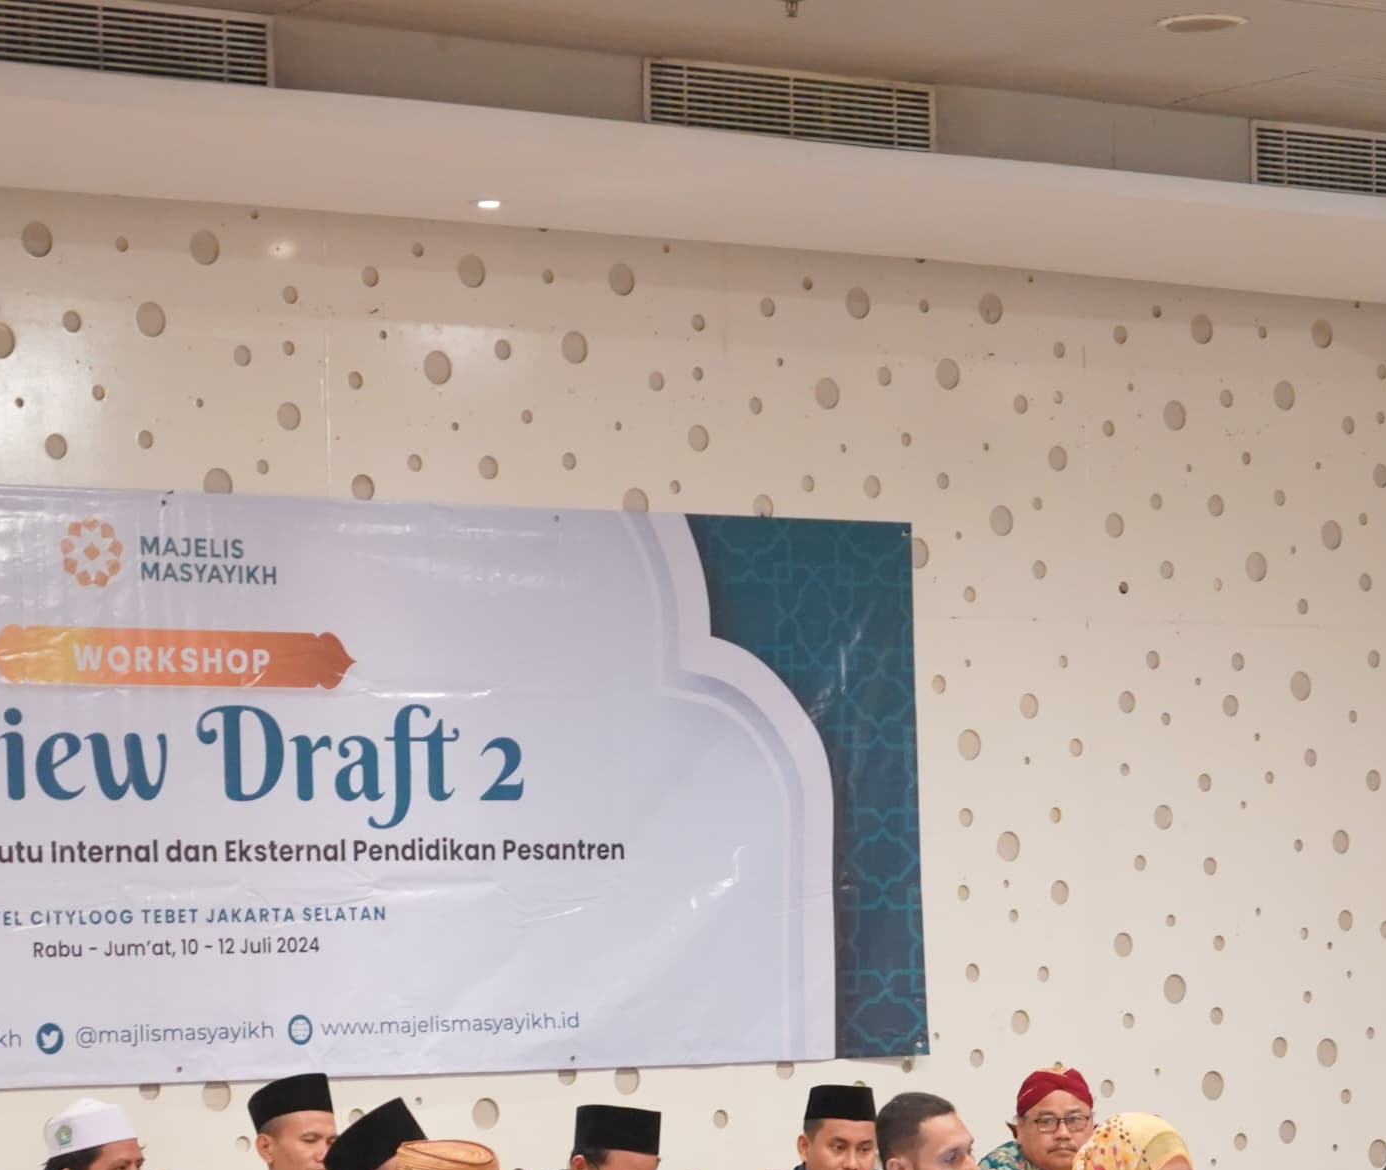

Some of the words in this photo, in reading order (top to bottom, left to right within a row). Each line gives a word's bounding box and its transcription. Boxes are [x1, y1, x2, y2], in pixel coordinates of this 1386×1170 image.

[140, 535, 245, 559] MAJELIS
[140, 561, 278, 586] MASYAYIKH
[73, 642, 271, 675] WORKSHOP
[196, 702, 460, 829] Draft
[479, 739, 525, 802] 2
[50, 838, 159, 863] Internal
[165, 839, 218, 863] dan
[224, 838, 347, 863] Eksternal
[352, 837, 496, 862] Pendidikan
[502, 838, 625, 861] Pesantren
[141, 908, 199, 924] TEBET
[205, 907, 296, 923] JAKARTA
[302, 906, 387, 922] SELATAN
[33, 939, 83, 958] Rabu
[181, 937, 199, 956] 10
[218, 937, 236, 955] 12
[240, 936, 272, 954] Juli
[276, 936, 320, 954] 2024
[75, 1020, 275, 1049] @majlismasyayikh
[320, 1010, 580, 1040] www.majelismasyayikh.id
